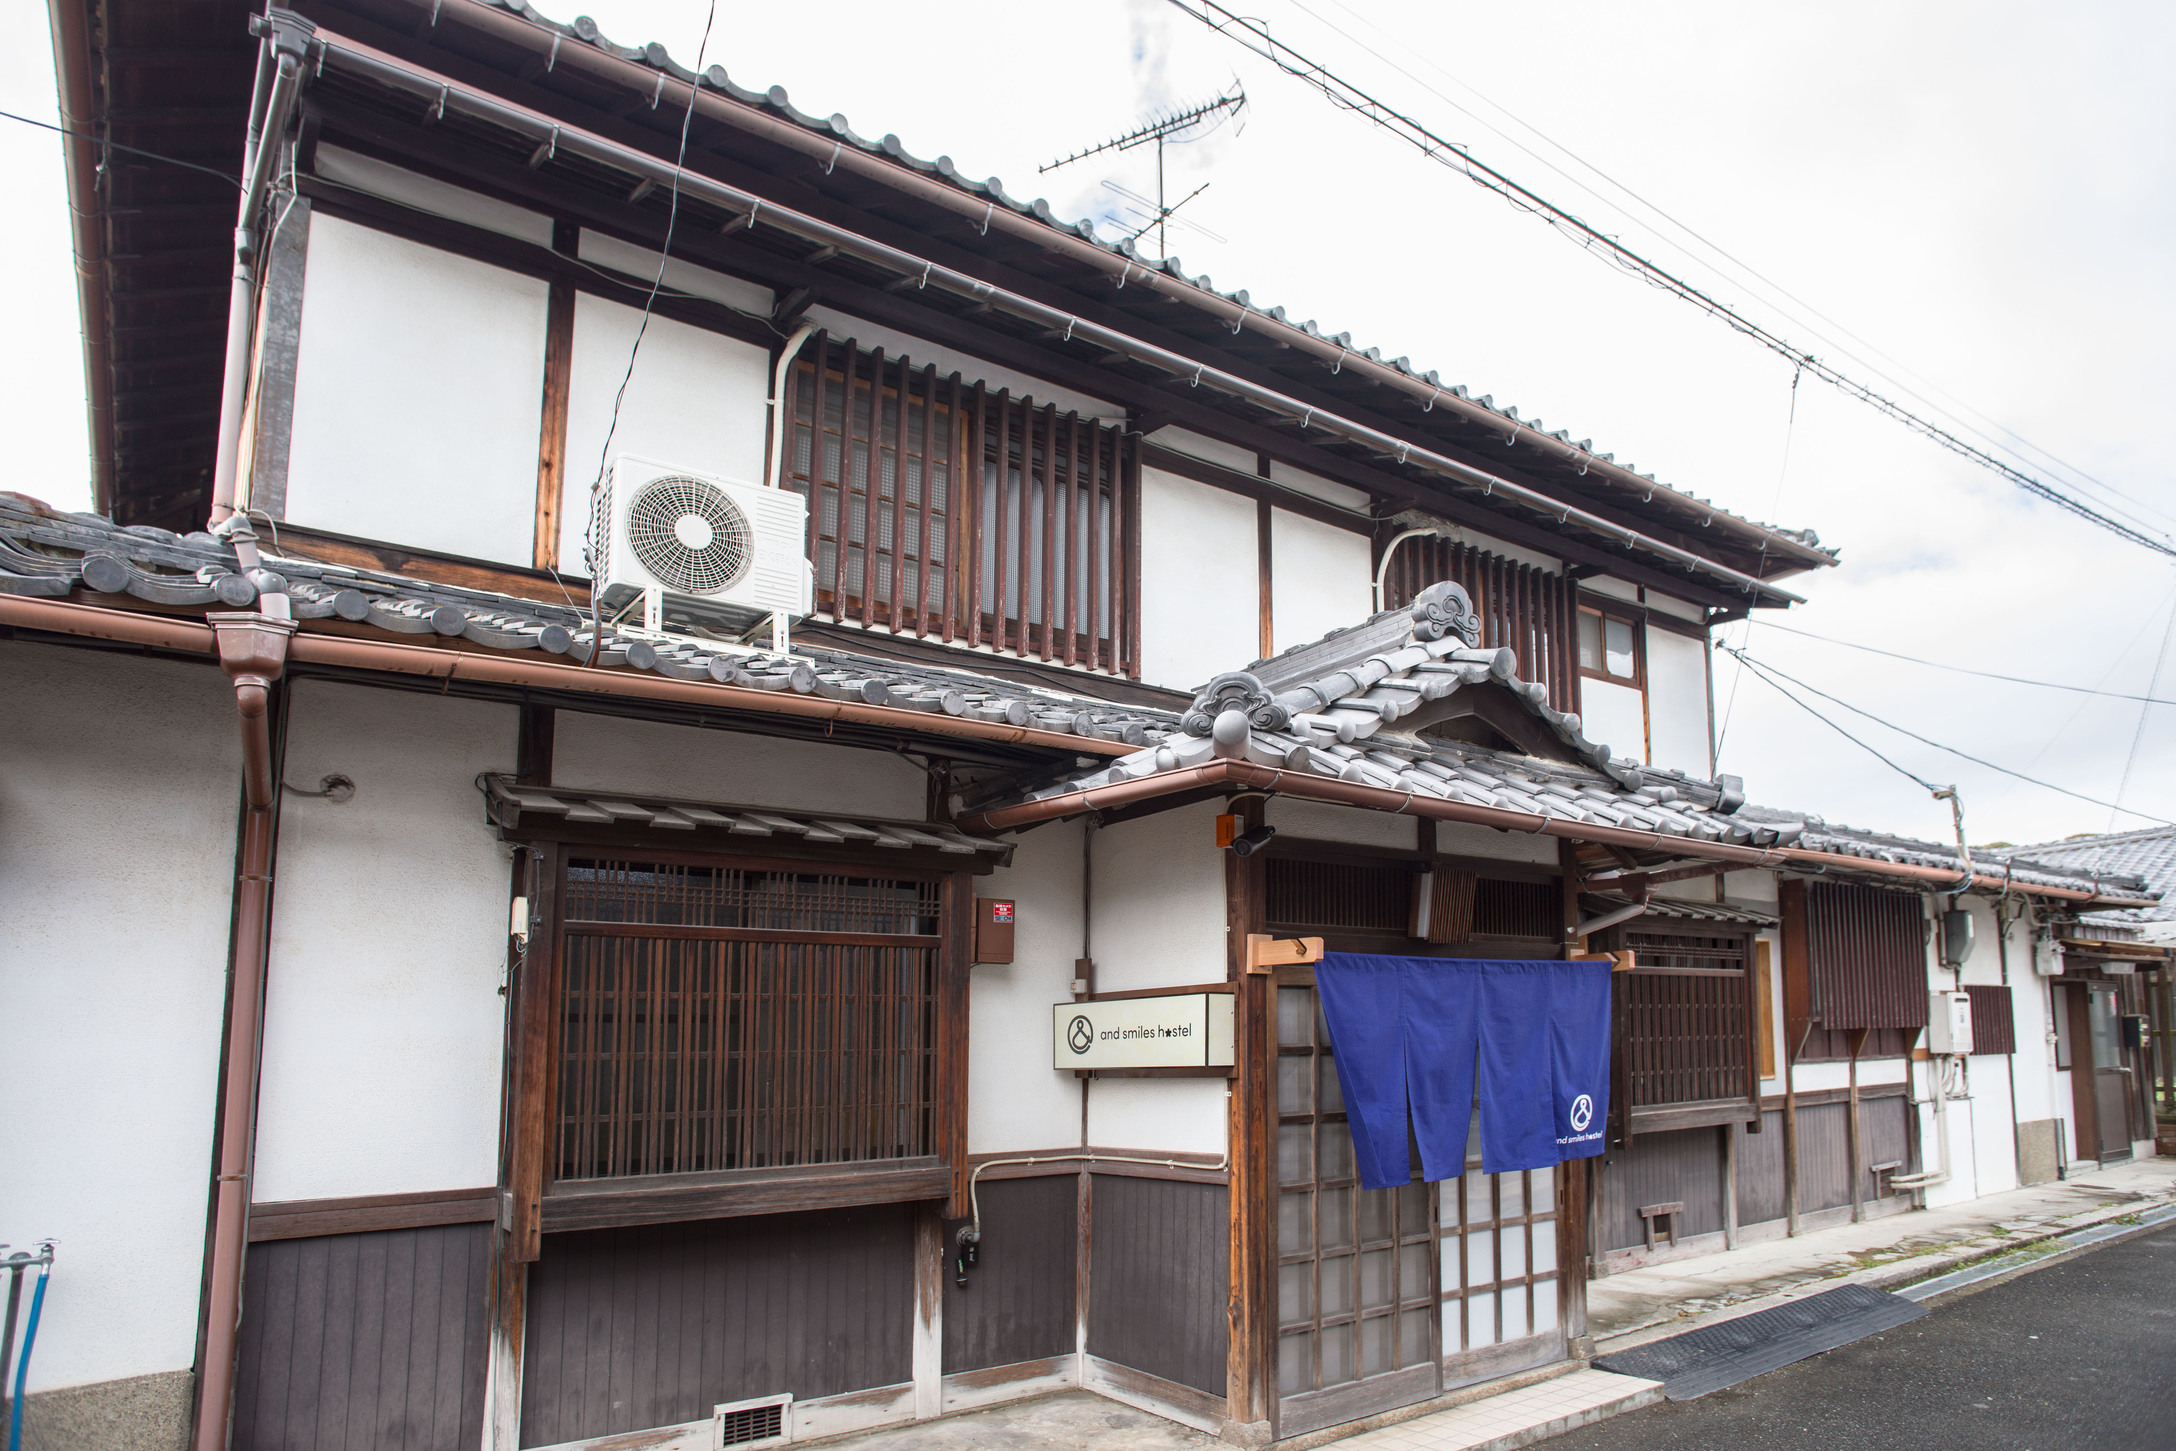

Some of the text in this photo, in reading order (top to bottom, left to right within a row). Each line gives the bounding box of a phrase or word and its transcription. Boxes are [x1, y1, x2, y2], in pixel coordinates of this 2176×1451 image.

[1100, 1026, 1120, 1040] and
[1122, 1025, 1155, 1039] smiles
[1556, 1136, 1568, 1144] nd
[1568, 1134, 1585, 1143] smiles
